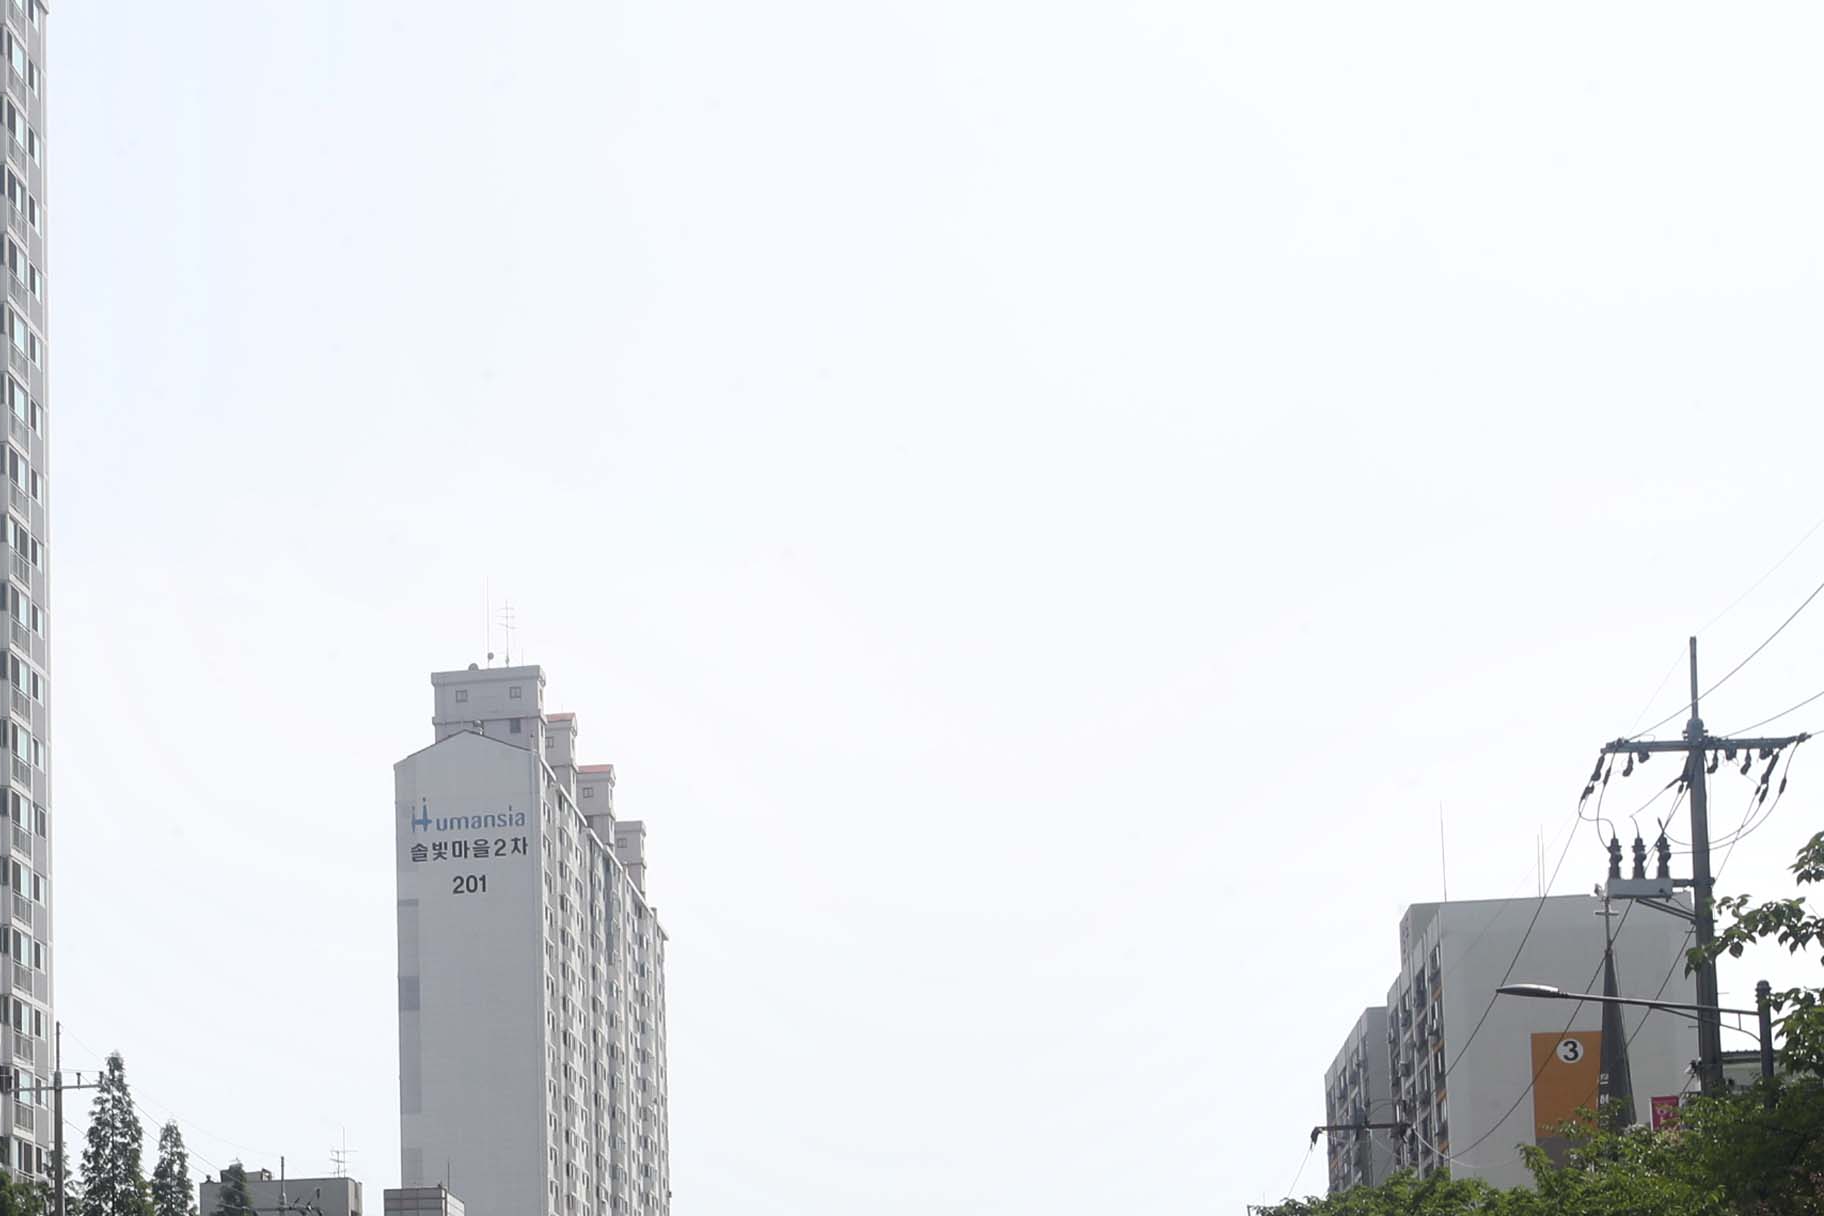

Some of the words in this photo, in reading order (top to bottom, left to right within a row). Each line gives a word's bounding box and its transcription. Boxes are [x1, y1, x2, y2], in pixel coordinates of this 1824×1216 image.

[411, 797, 526, 833] Humansia
[410, 836, 528, 863] 솔빛마을2차
[452, 874, 487, 894] 201
[1563, 1040, 1579, 1061] 3
